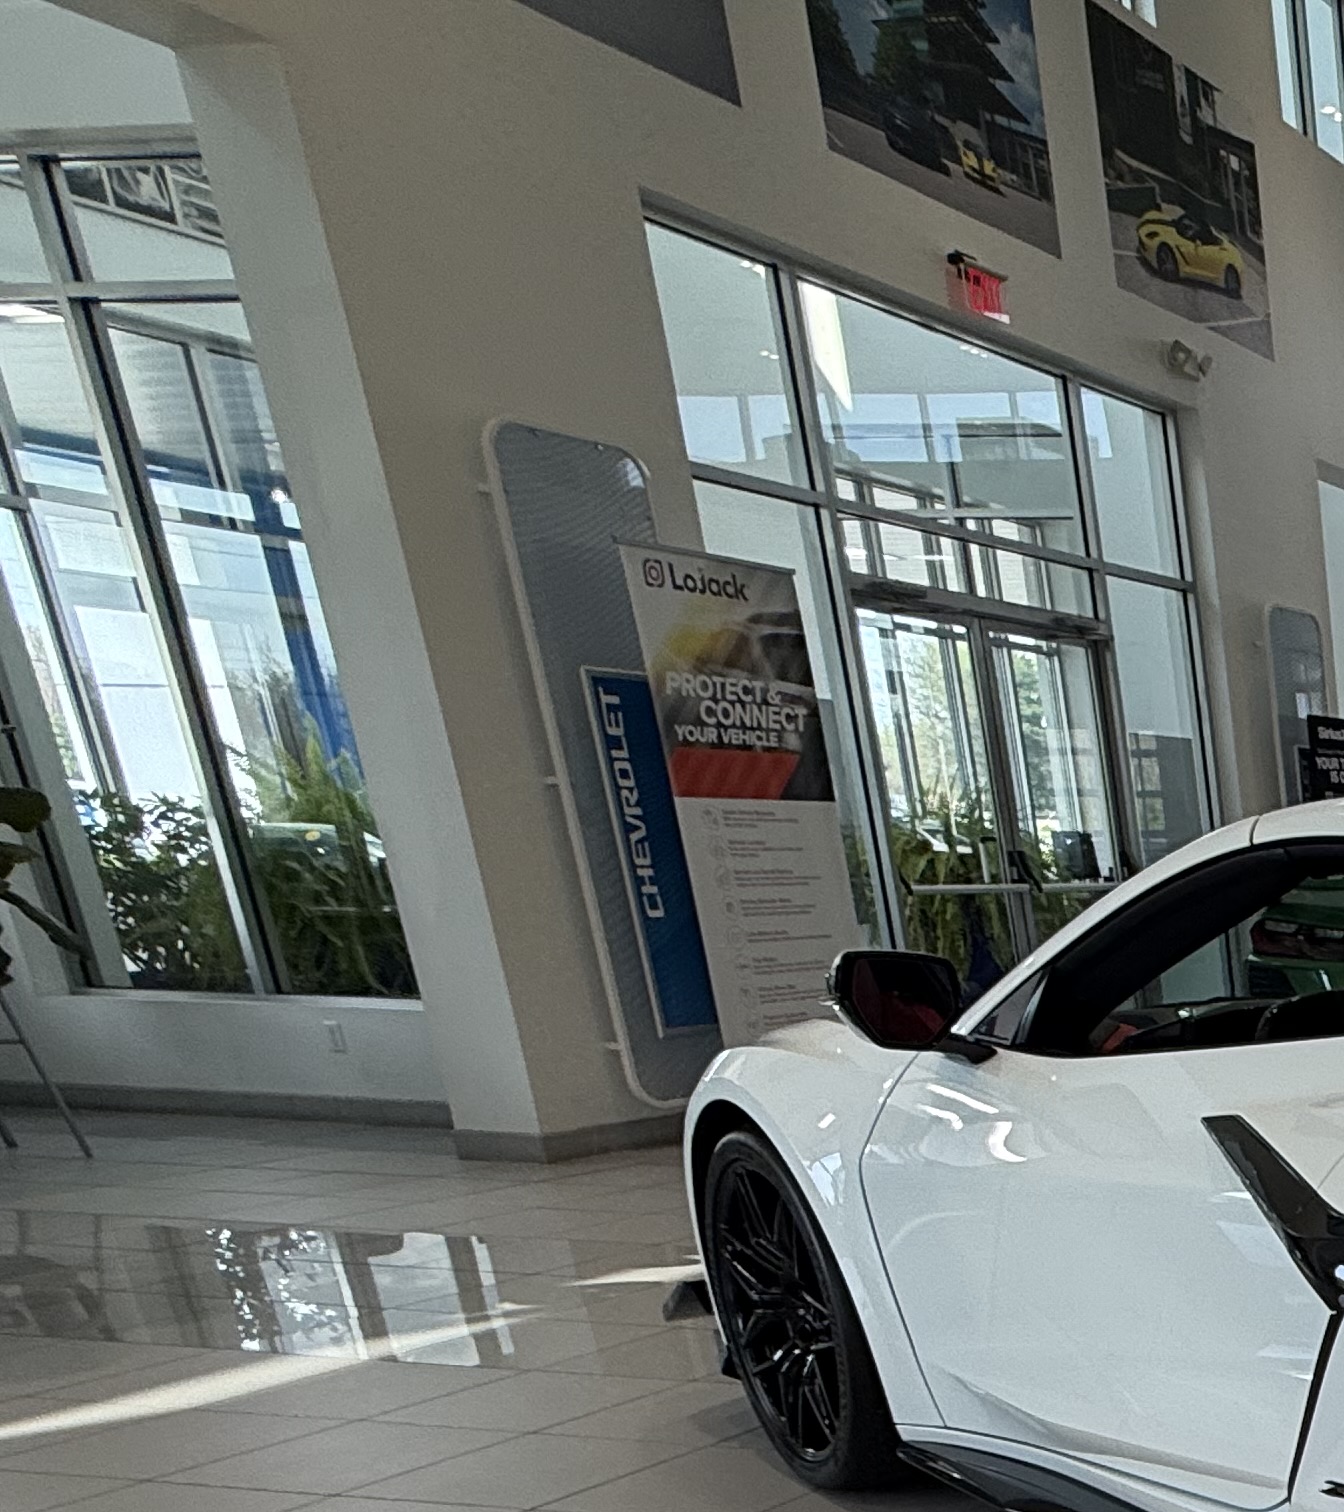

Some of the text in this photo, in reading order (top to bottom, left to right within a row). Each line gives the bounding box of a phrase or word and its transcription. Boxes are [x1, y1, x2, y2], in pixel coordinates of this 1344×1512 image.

[666, 672, 782, 705] PROTECT &
[700, 701, 807, 732] CONNECT
[674, 724, 779, 747] YOUR VEHICLE
[599, 687, 665, 918] CHEVROLET
